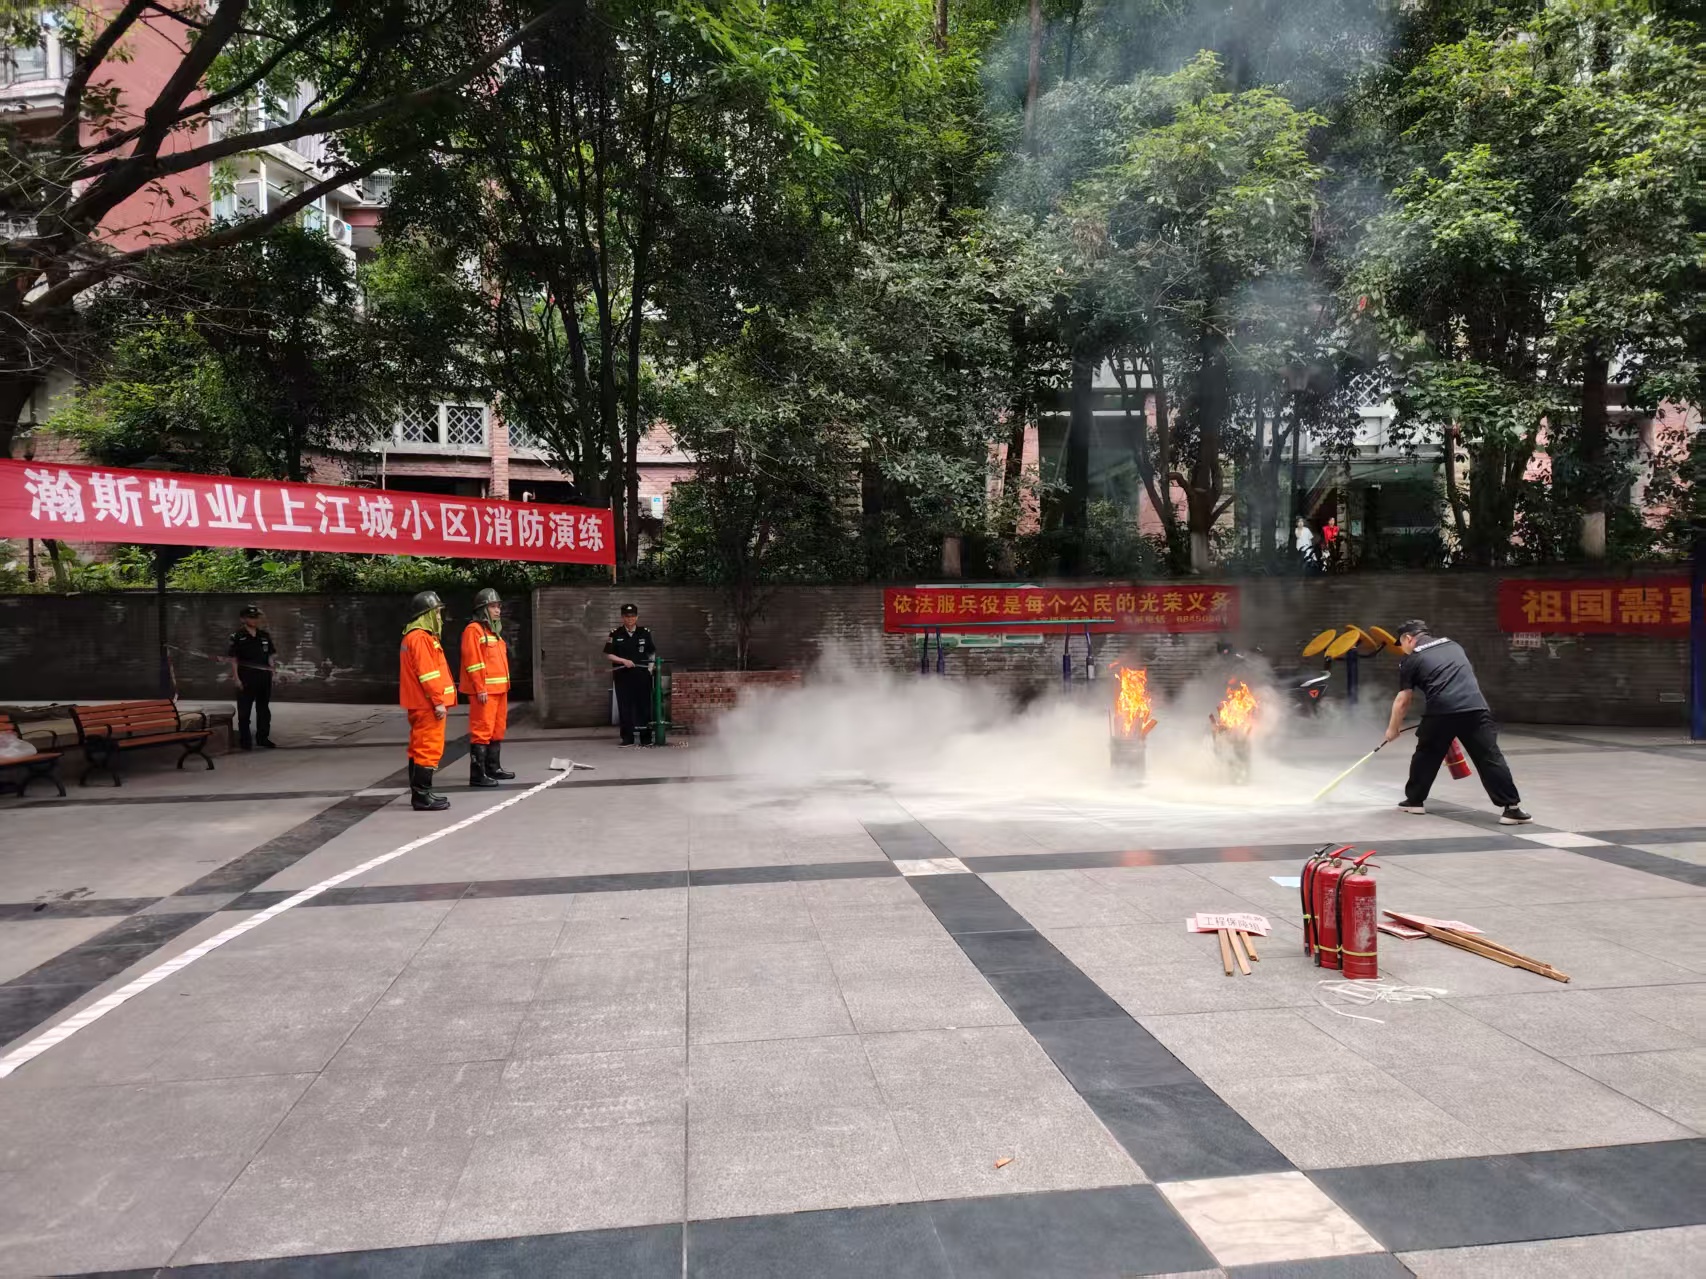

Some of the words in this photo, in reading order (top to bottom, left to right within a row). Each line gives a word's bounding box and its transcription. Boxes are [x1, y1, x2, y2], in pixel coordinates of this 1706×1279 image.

[24, 467, 605, 554] 瀚斯物业(上江城小区)消防演练
[893, 590, 1232, 615] 依法服兵役是每个公民的光荣义务
